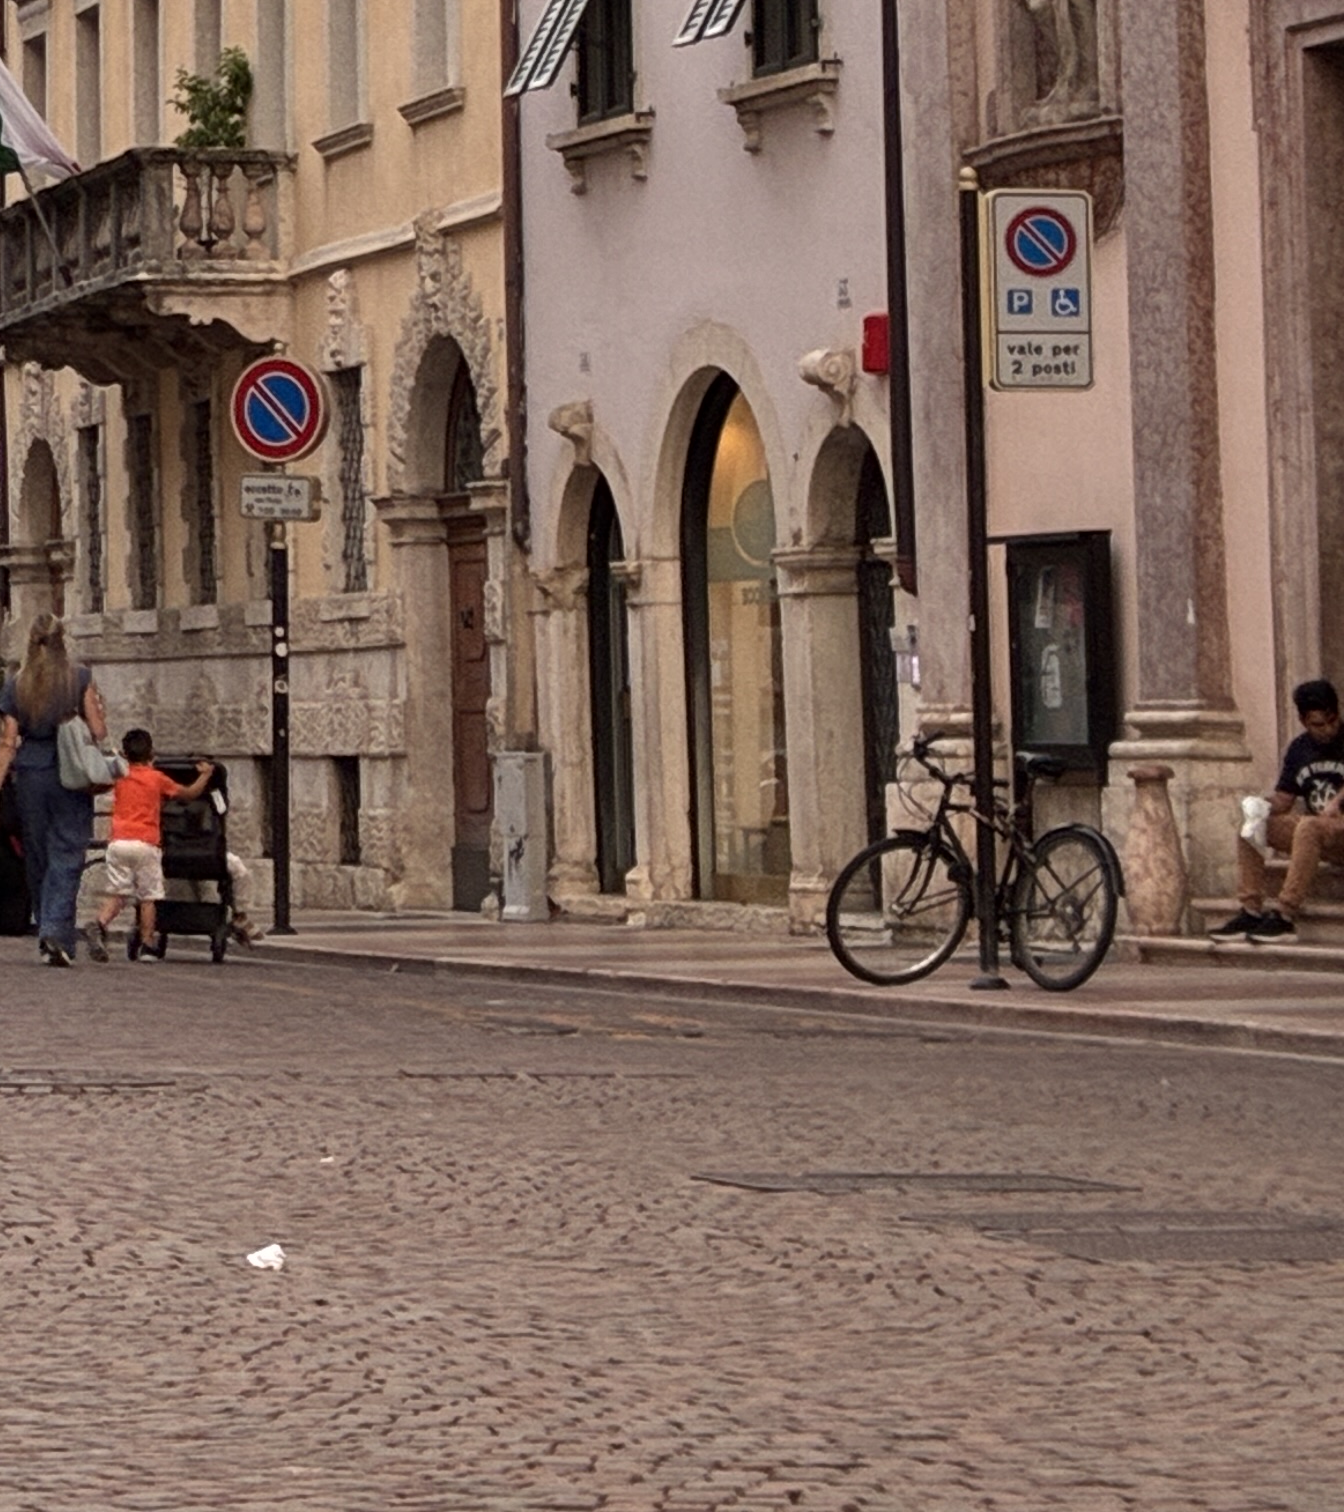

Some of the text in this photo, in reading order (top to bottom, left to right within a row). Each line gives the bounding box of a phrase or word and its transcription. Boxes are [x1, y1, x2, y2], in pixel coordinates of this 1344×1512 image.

[1006, 341, 1080, 360] vale per
[1011, 360, 1076, 377] 2 posti
